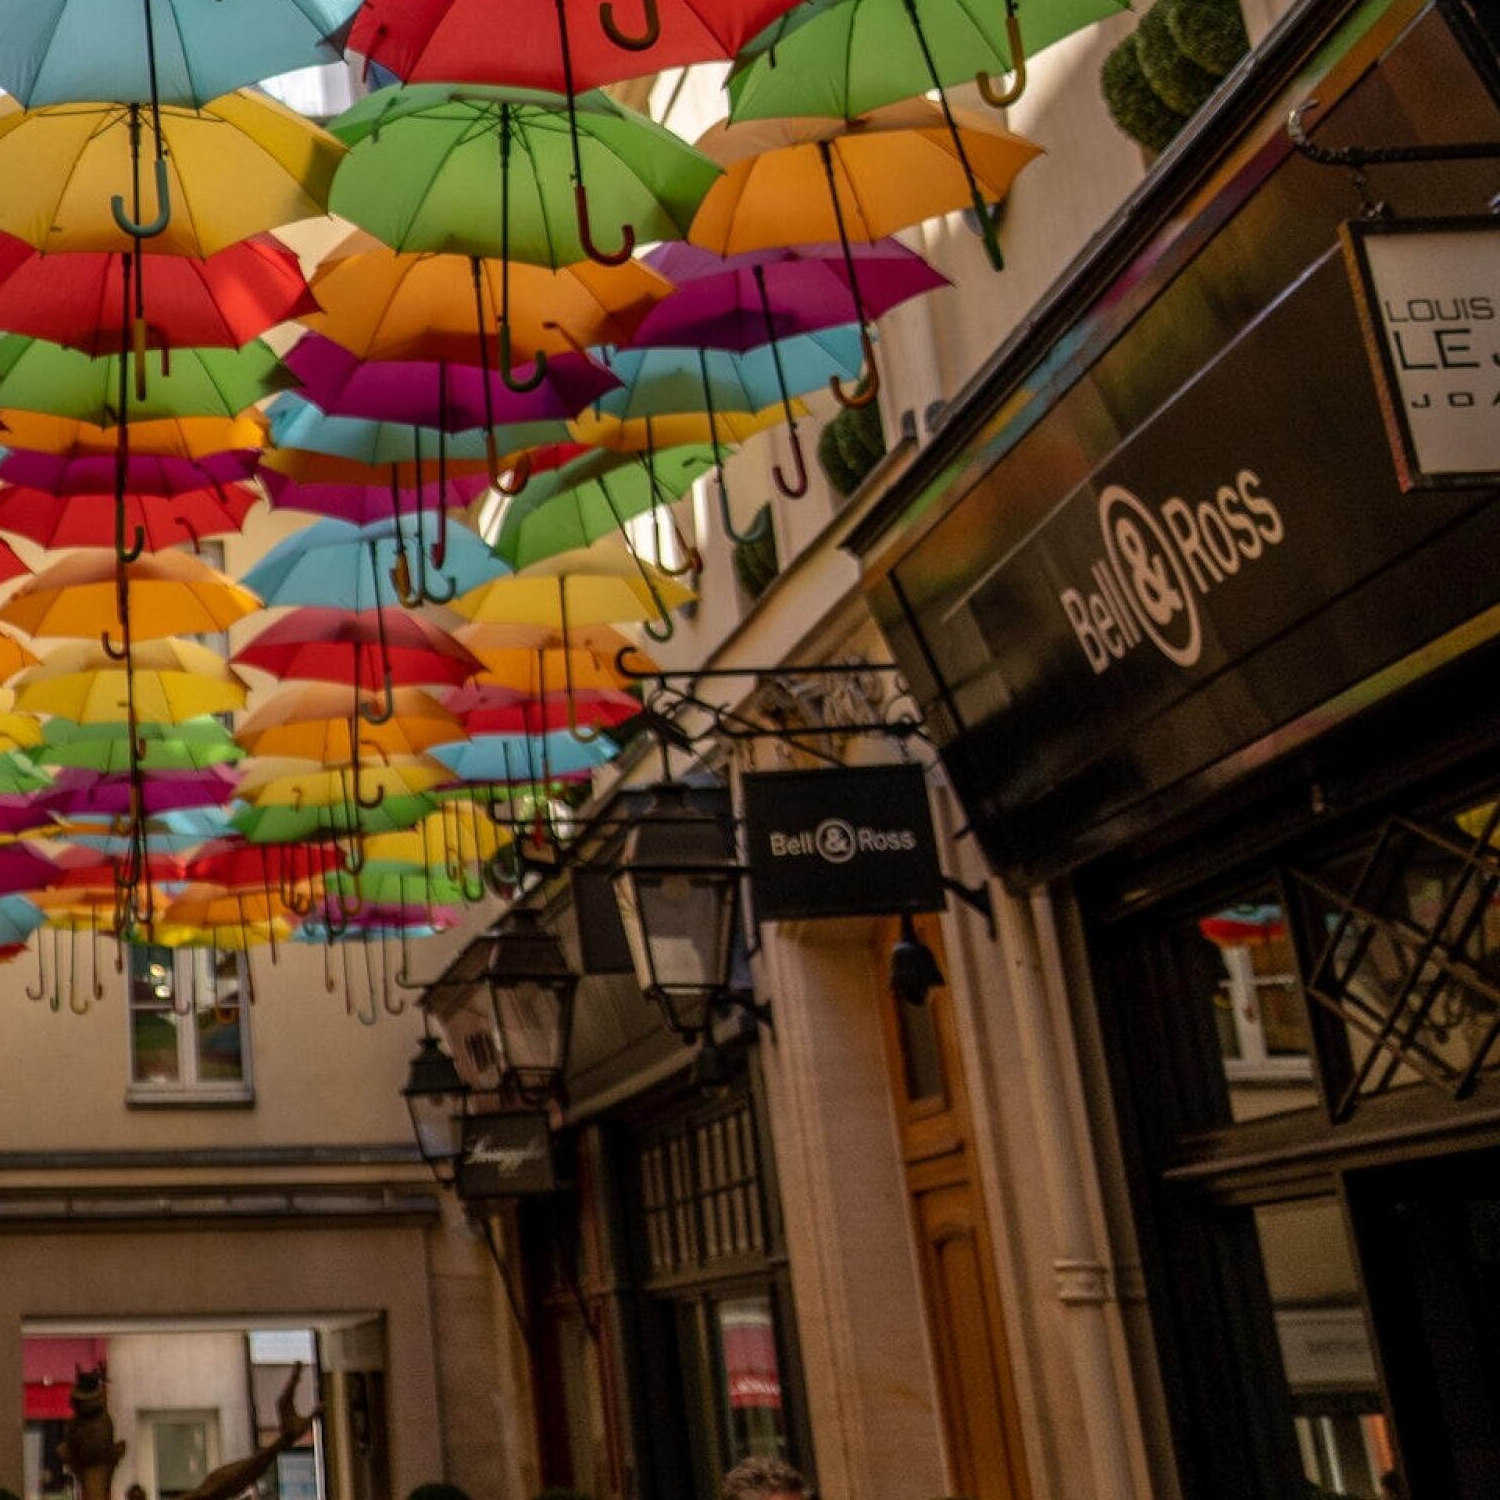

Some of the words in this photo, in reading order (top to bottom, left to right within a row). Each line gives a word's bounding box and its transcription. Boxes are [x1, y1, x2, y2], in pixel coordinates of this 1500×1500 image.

[1385, 297, 1495, 322] LOUIS
[1393, 328, 1480, 370] LE
[1061, 560, 1143, 675] Bell
[1161, 468, 1284, 594] Ross
[770, 831, 814, 856] Bell
[857, 827, 917, 851] Ross
